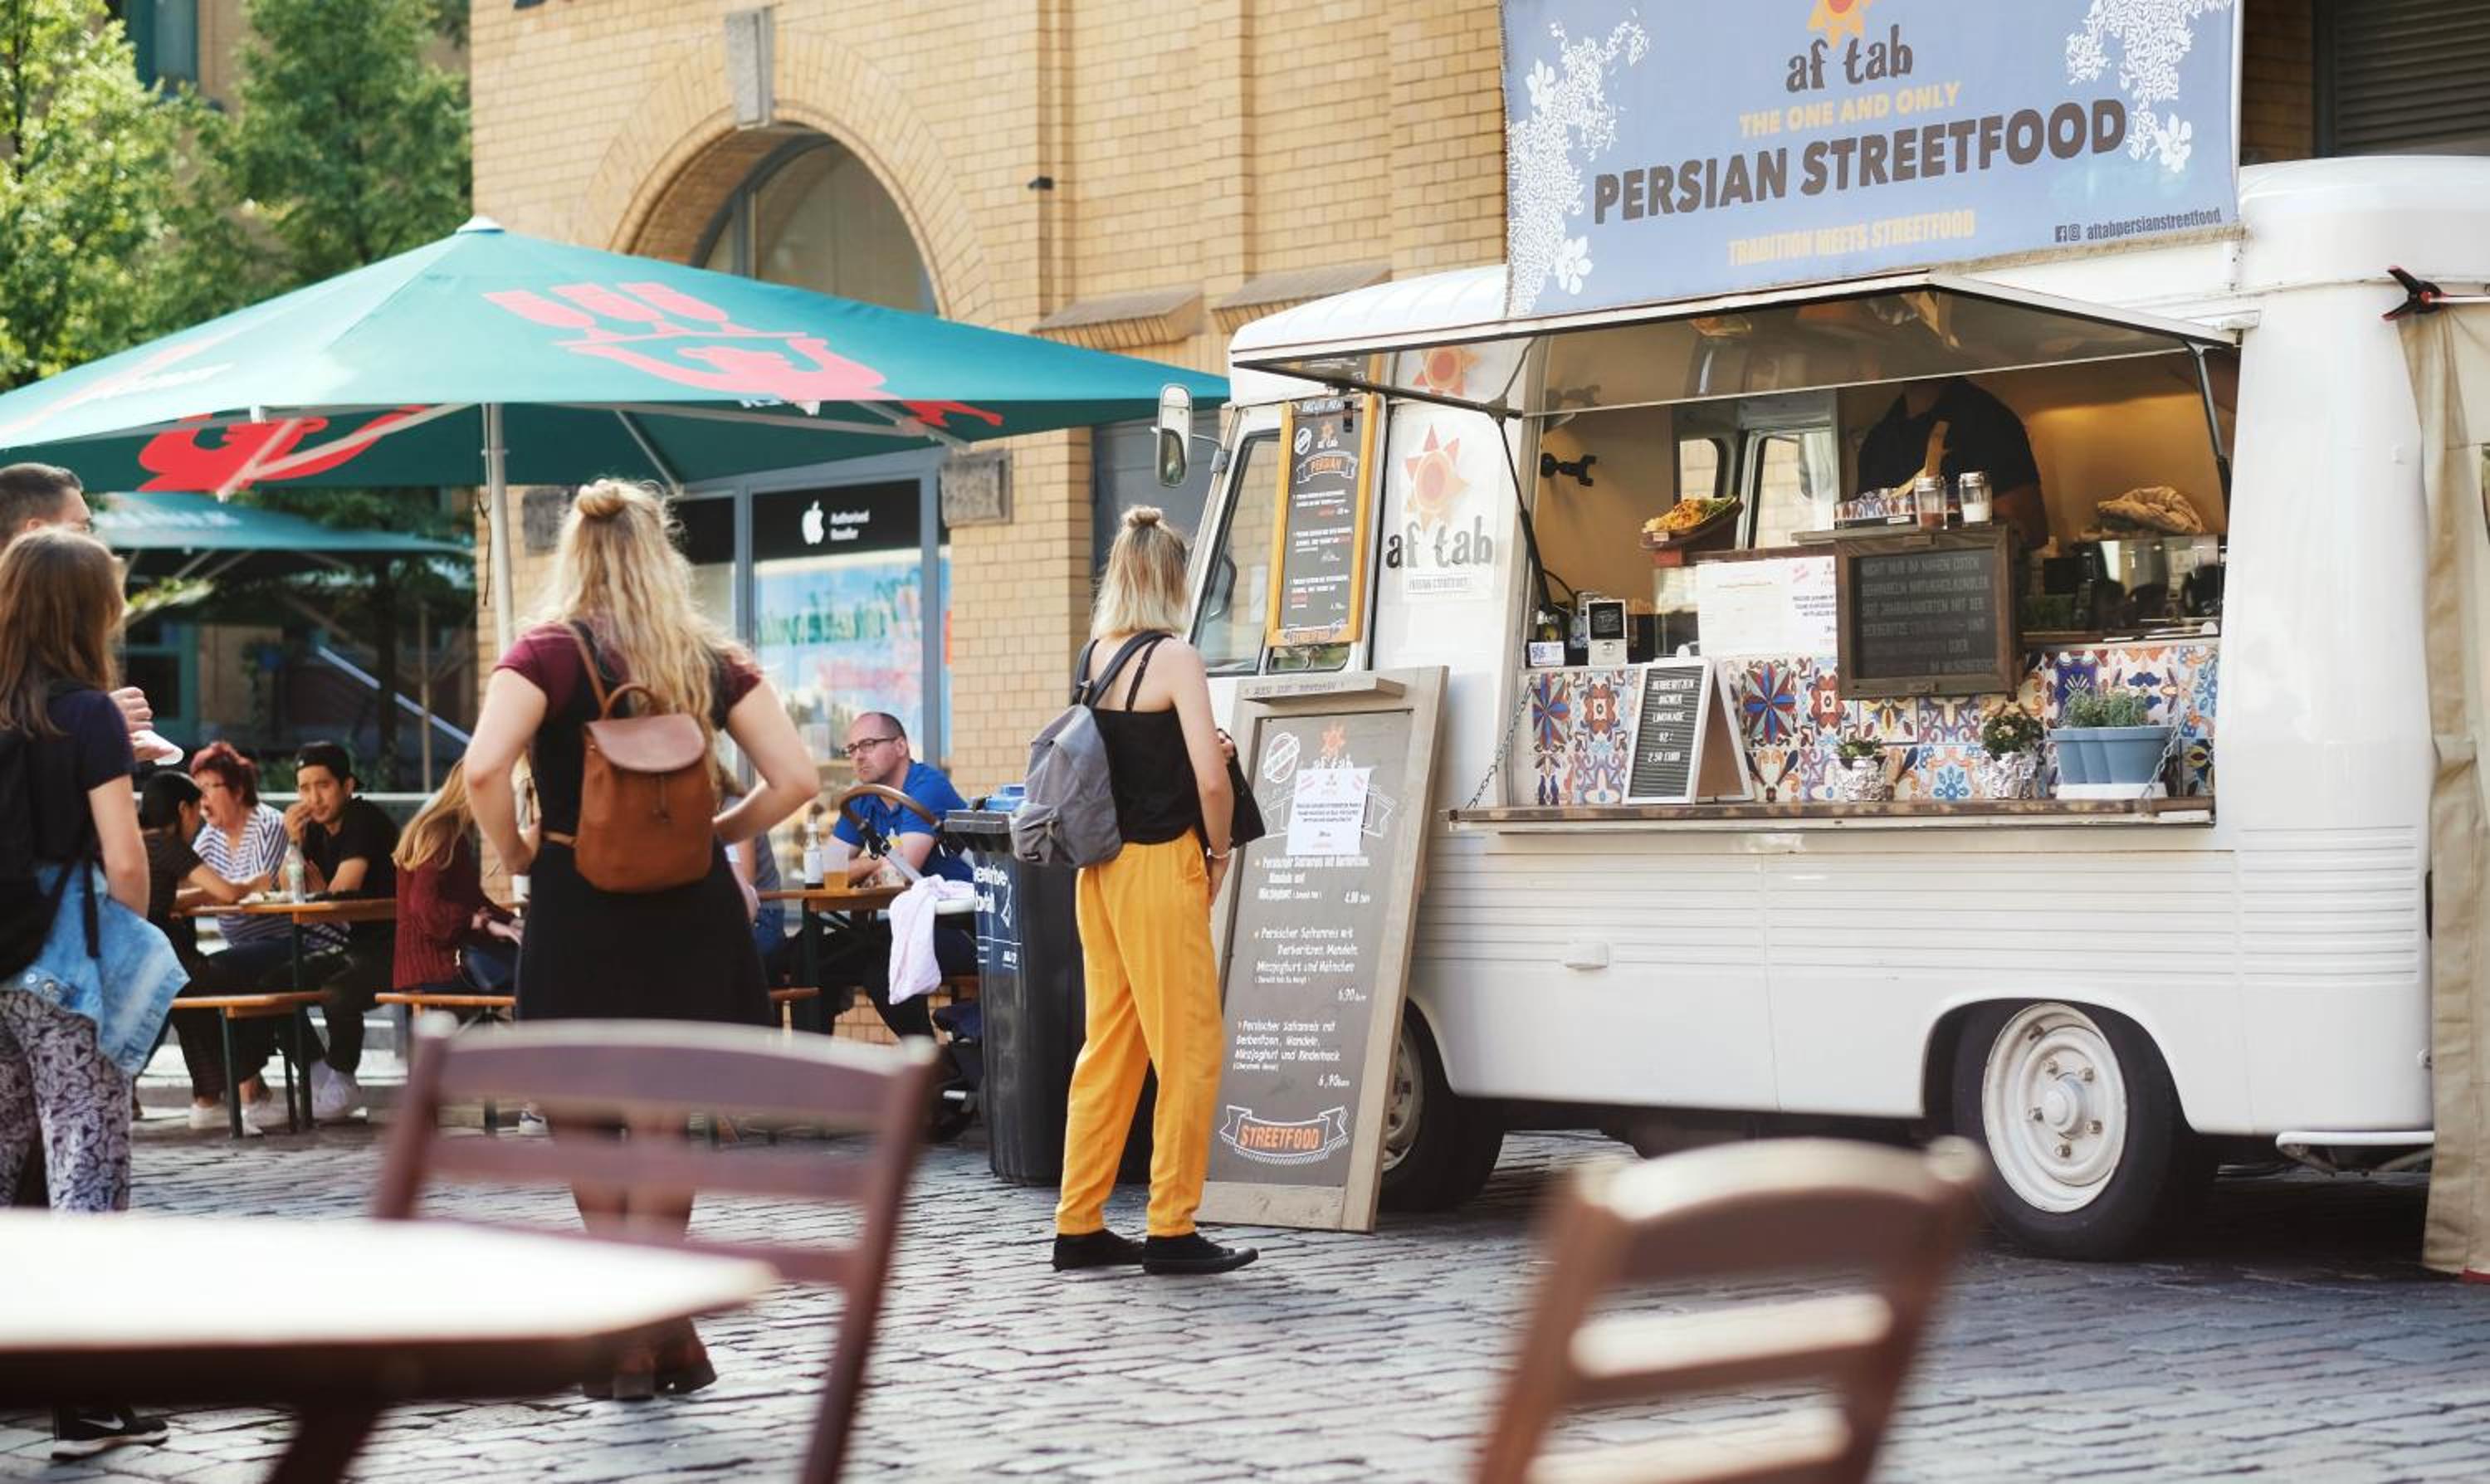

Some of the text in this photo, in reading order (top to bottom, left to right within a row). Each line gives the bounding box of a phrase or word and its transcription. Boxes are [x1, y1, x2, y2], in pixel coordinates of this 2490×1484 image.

[1785, 23, 1913, 93] af tab
[1739, 81, 1962, 138] THE ONE AND ONLY
[1594, 98, 2127, 225] PERSIAN STREETFOOD
[1728, 209, 1976, 266] TRADITION MEETS STREETFOOD
[2086, 207, 2223, 241] aftabpersianstreetfood
[1385, 515, 1494, 569] af tab
[1239, 1124, 1320, 1150] STREETFOOD
